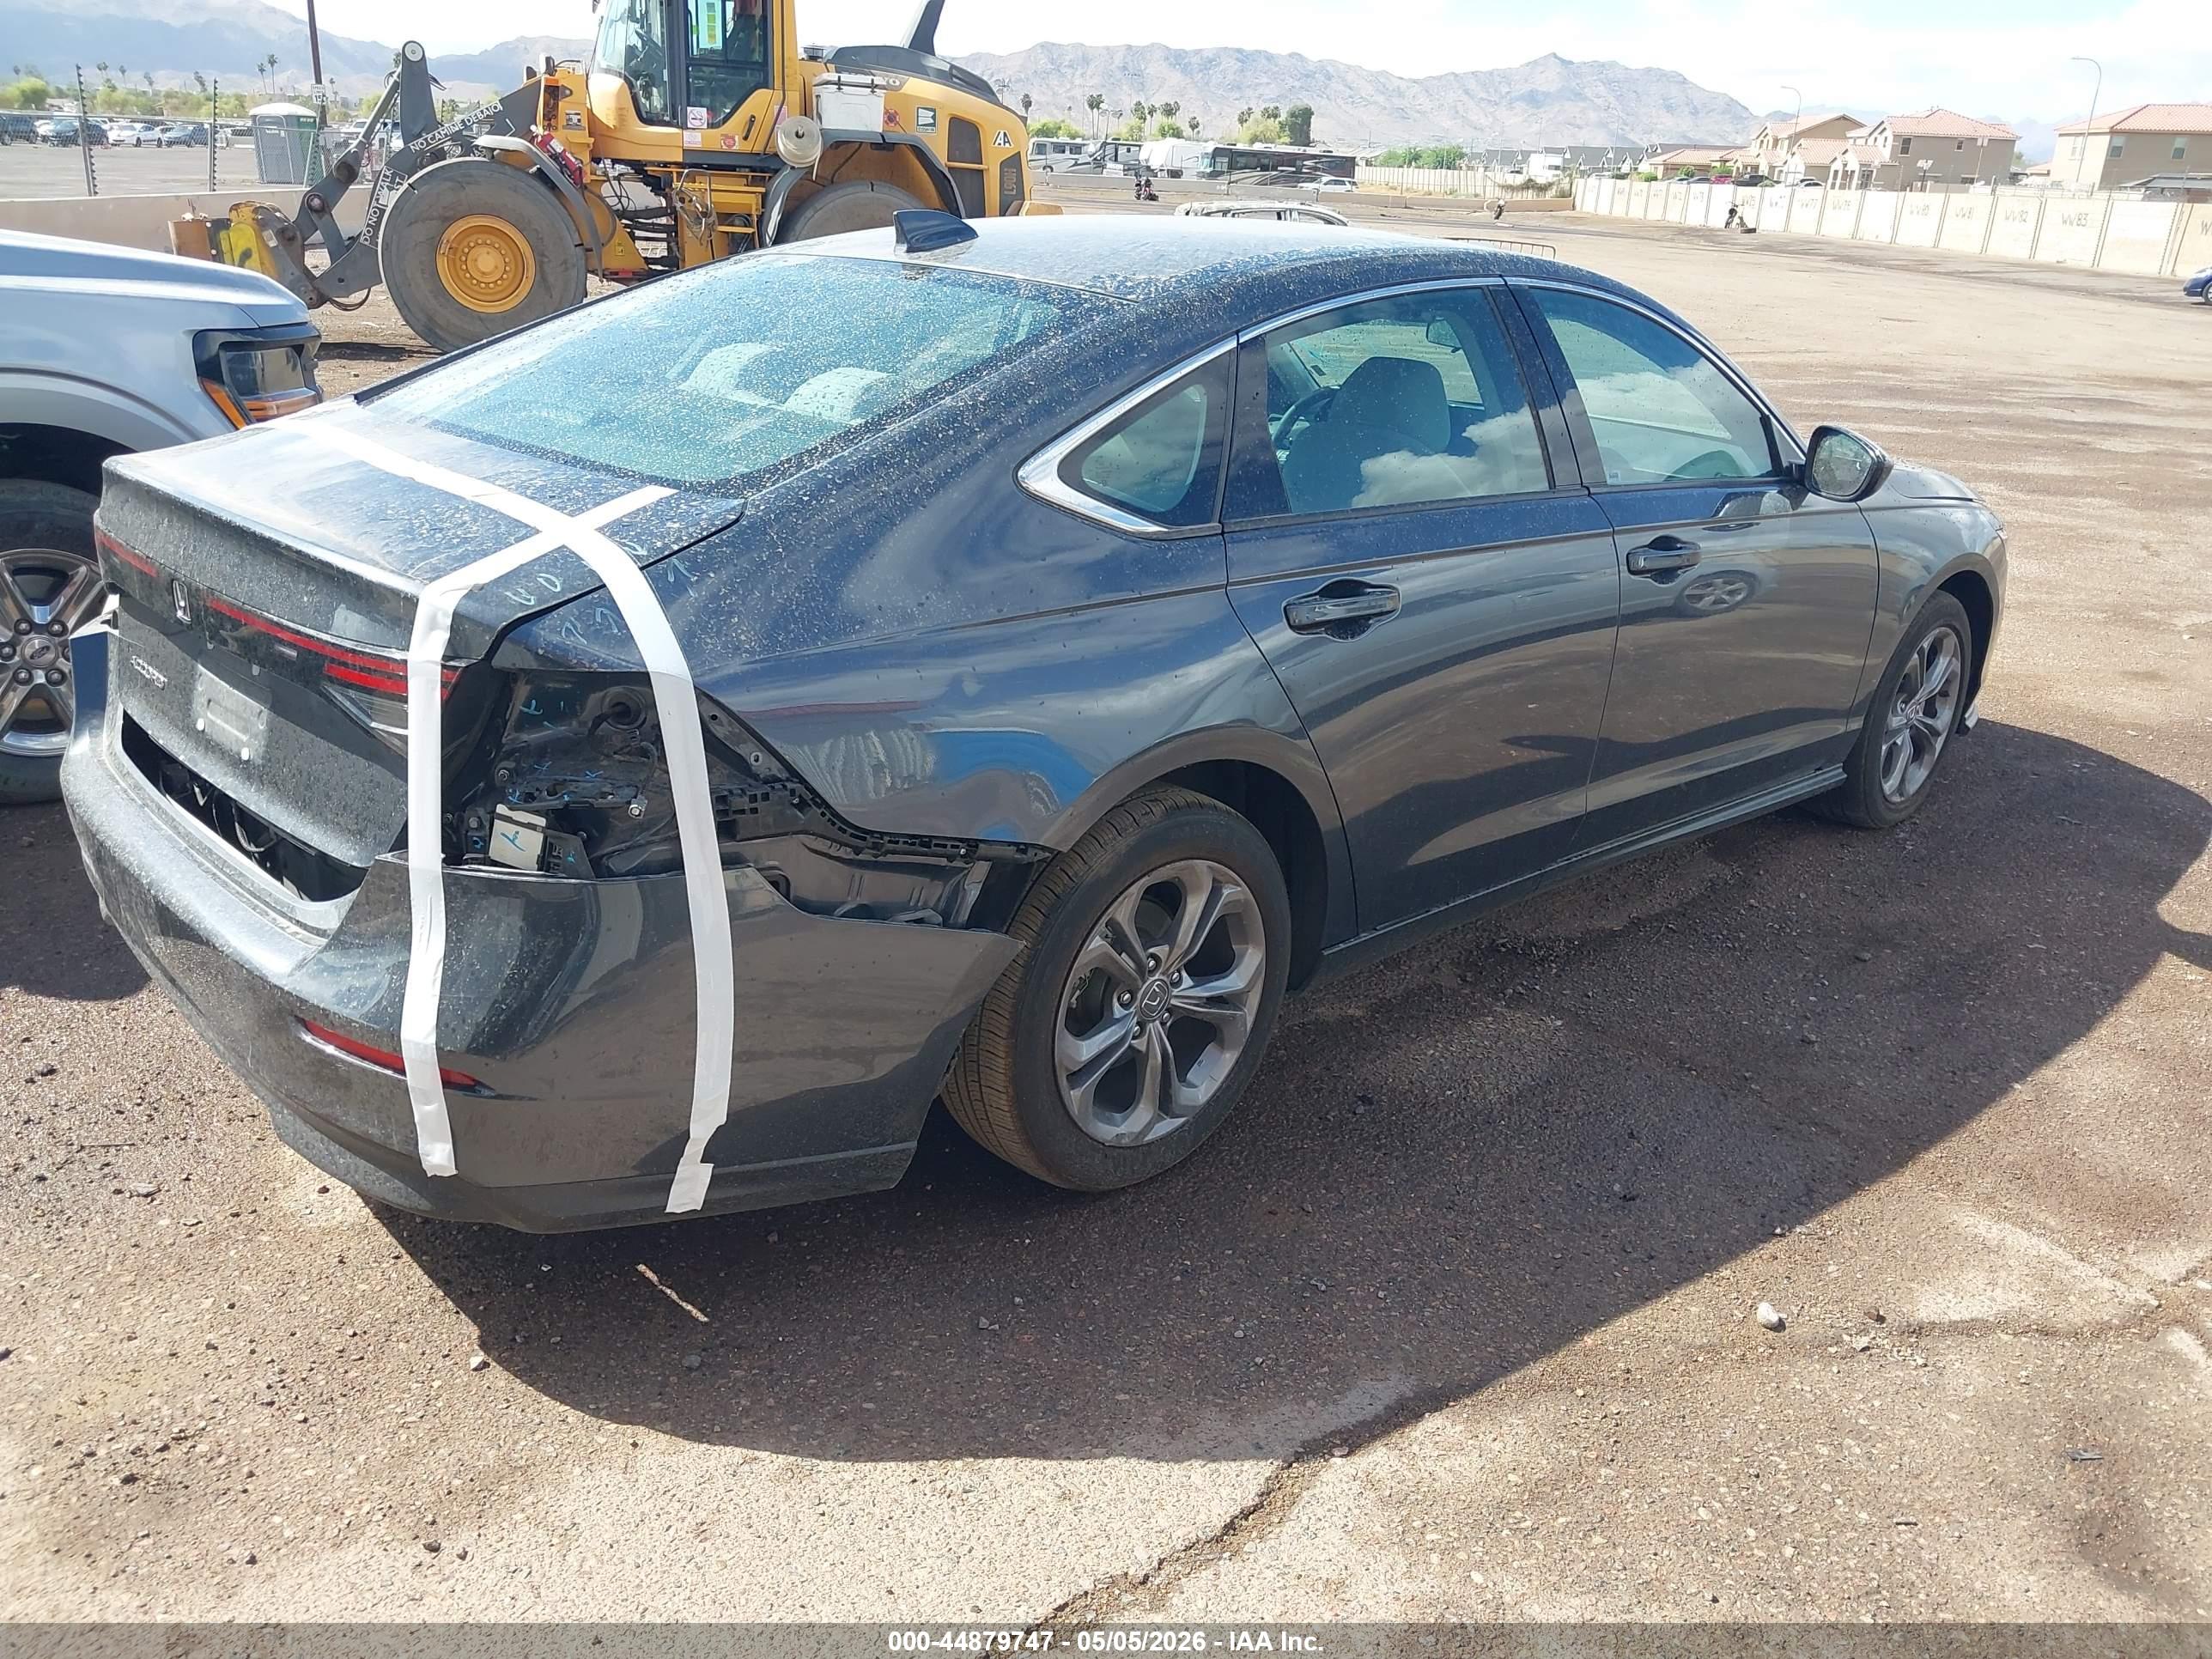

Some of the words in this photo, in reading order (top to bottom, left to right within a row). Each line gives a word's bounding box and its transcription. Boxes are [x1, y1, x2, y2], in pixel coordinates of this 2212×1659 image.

[409, 139, 427, 153] NO
[428, 121, 465, 144] CAMINE
[465, 103, 500, 126] DEBAJO
[1004, 168, 1017, 195] L90H
[362, 227, 374, 245] DO
[368, 202, 381, 226] NOT
[377, 167, 394, 200] WALK
[2062, 213, 2088, 227] WW83
